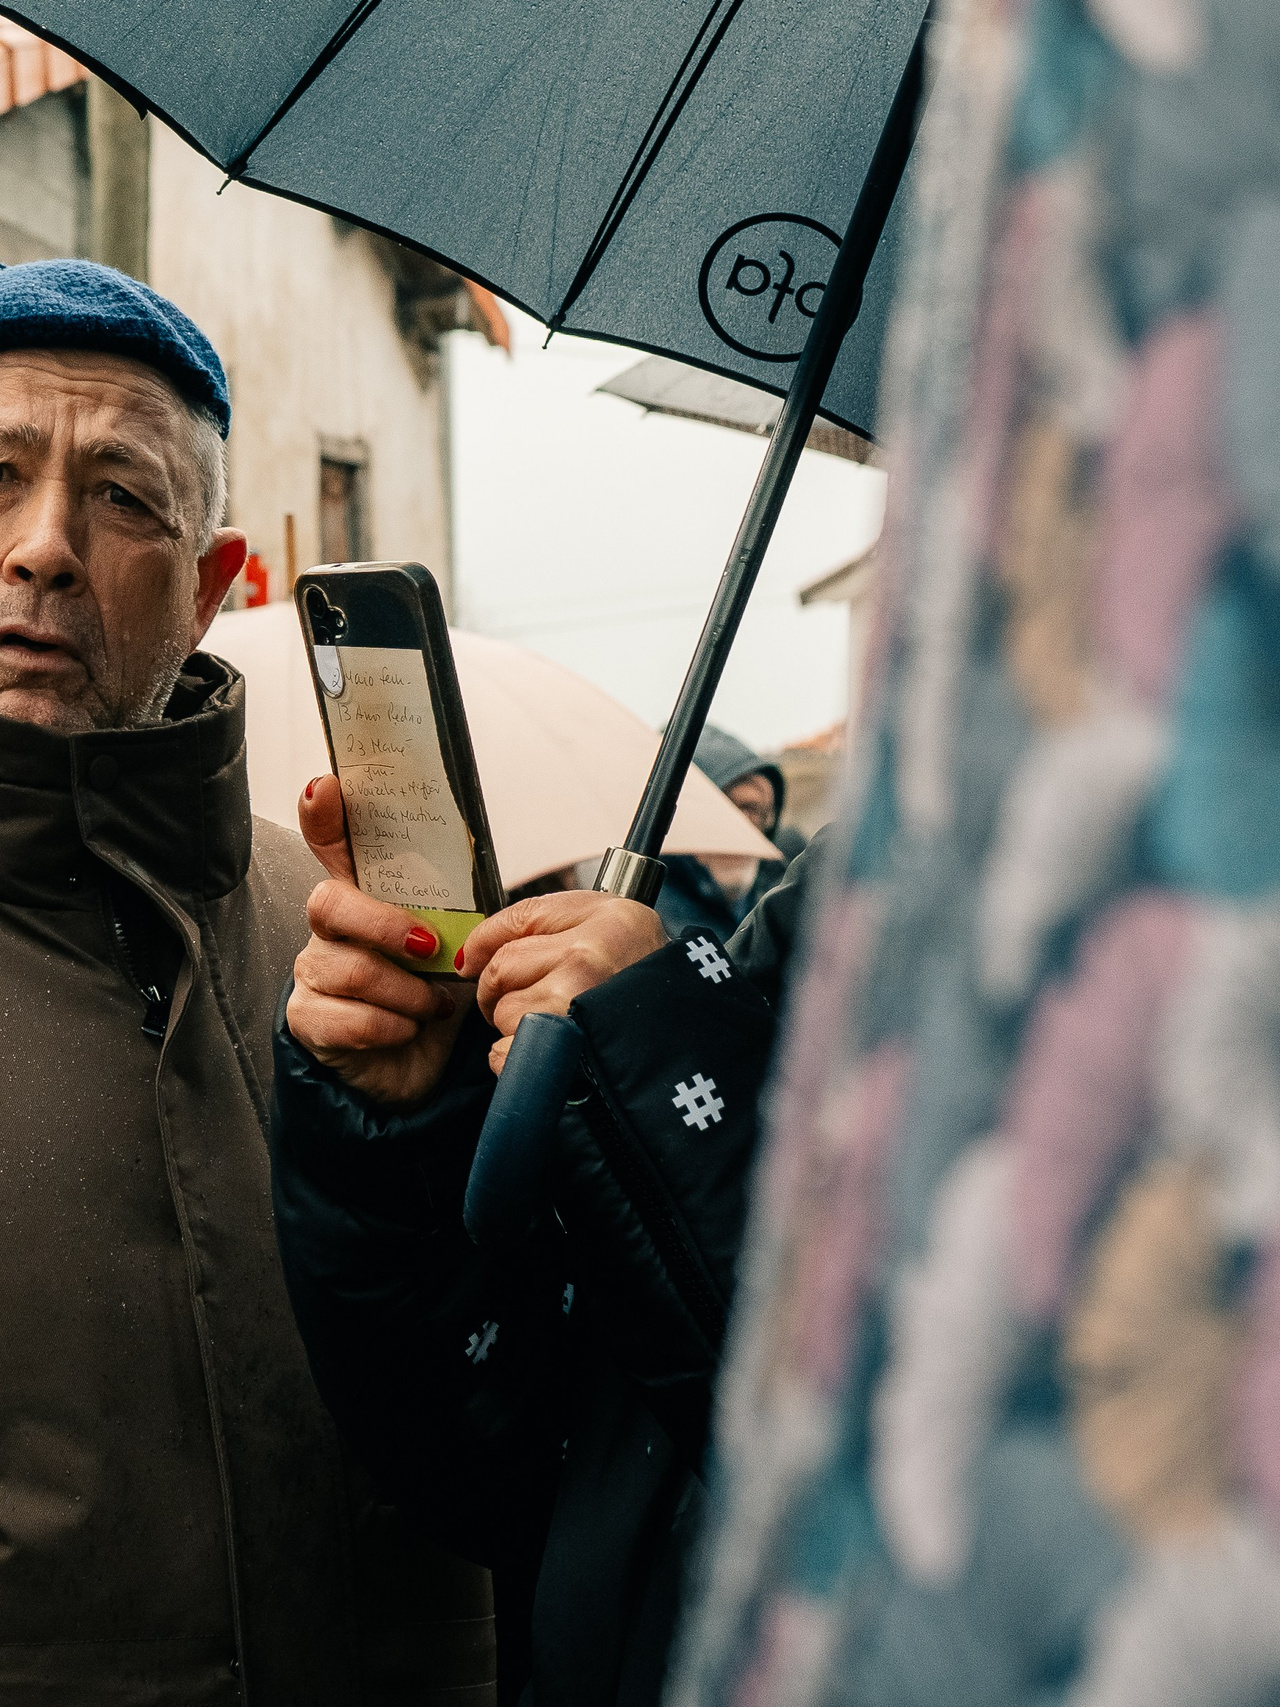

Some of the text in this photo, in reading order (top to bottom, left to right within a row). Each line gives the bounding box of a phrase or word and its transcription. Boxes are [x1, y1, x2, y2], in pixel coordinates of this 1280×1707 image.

[346, 733, 366, 757] 23
[368, 801, 398, 824] Paula
[374, 826, 412, 842] David
[411, 884, 450, 898] Coelho
